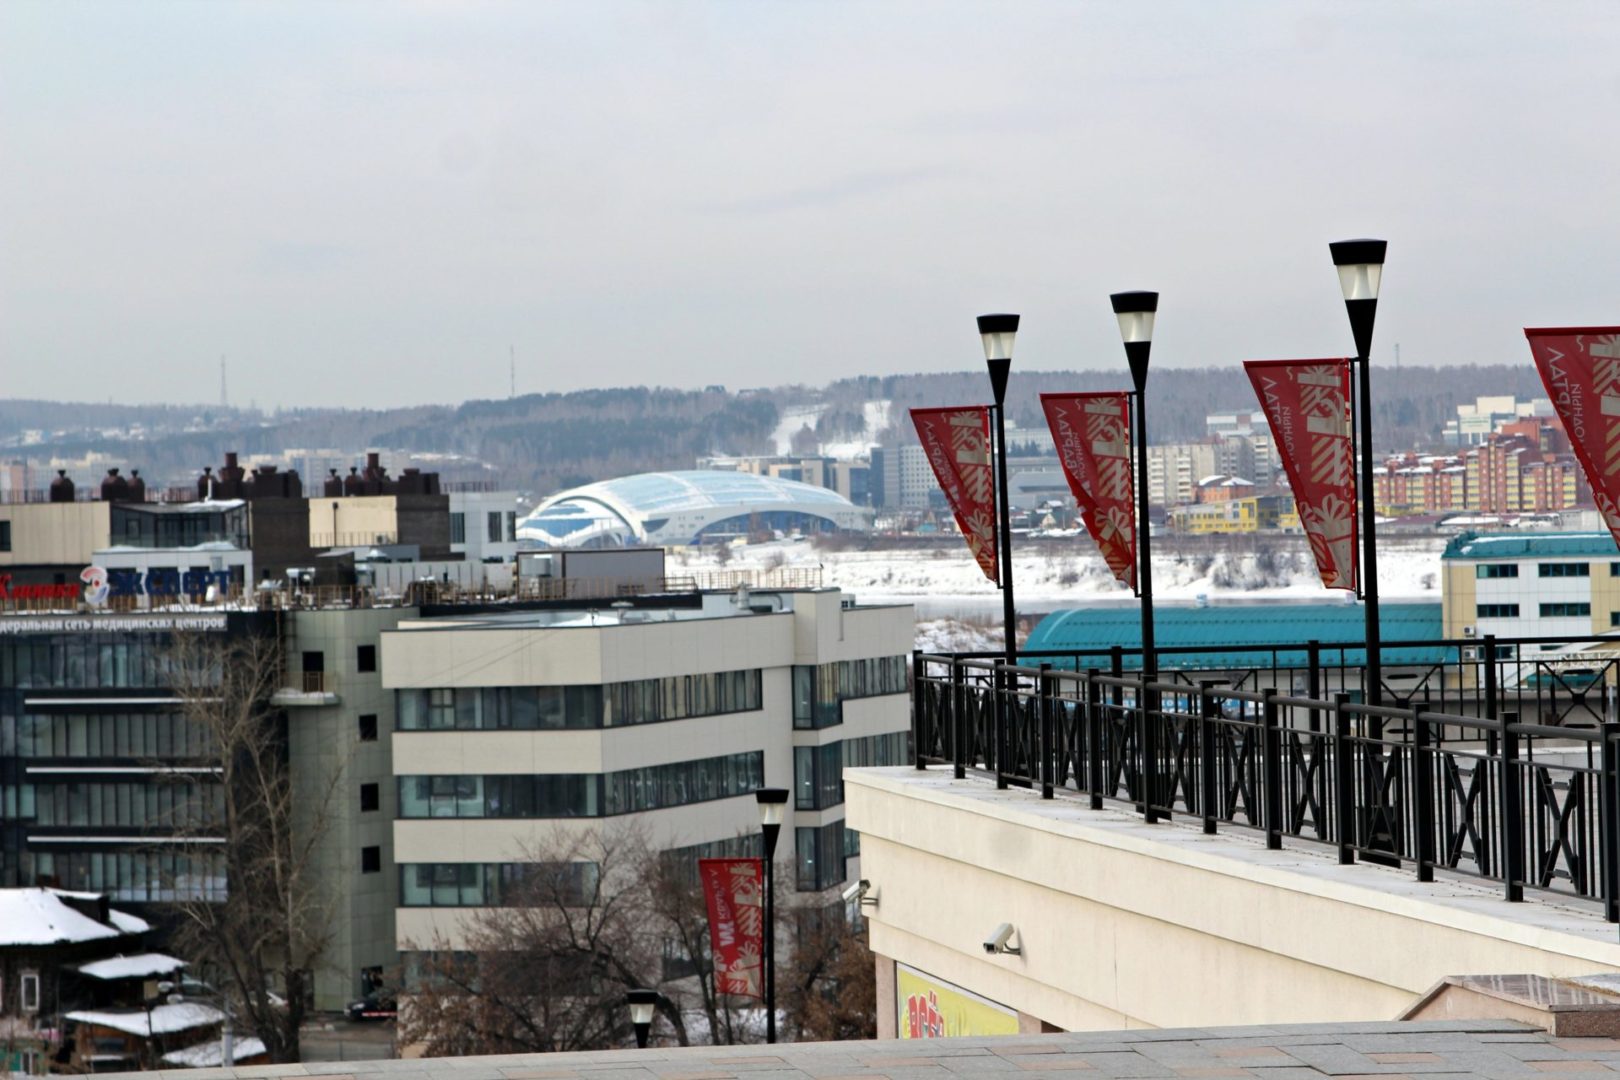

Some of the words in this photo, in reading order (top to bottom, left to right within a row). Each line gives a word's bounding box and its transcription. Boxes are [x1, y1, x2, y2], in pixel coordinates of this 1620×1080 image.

[64, 620, 91, 631] сеть
[93, 619, 173, 632] медицинских
[175, 618, 225, 632] центров
